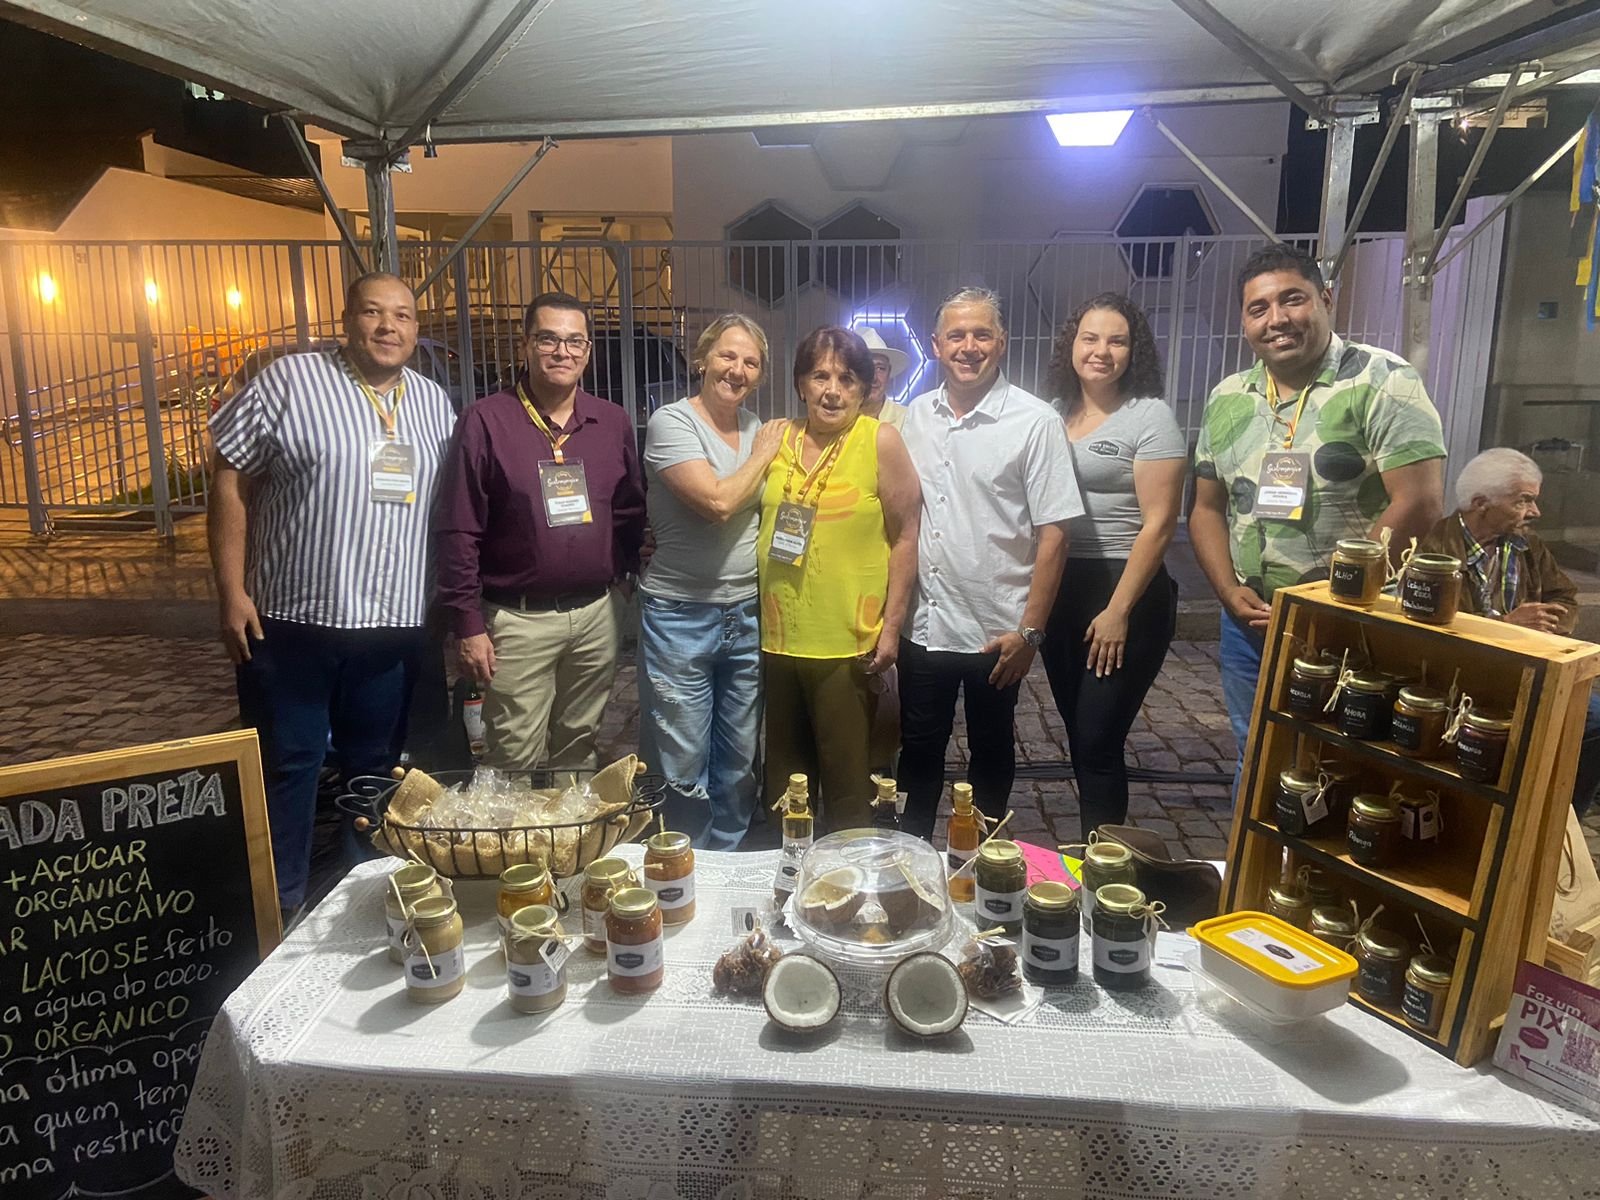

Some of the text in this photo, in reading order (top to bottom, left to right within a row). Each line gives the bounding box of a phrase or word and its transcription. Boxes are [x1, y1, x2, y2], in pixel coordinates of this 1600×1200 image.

[1334, 569, 1353, 581] ALHO
[101, 769, 226, 832] PRETA
[15, 868, 153, 918] ORGÂNICA
[54, 890, 195, 940] MASCAVO
[22, 936, 149, 994] LACTOSE
[163, 915, 233, 960] feito
[35, 988, 107, 1027] água
[113, 971, 146, 1000] do
[1520, 999, 1564, 1037] PIX
[1526, 984, 1554, 1006] Faz
[35, 996, 189, 1051] ORGÂNICO
[46, 1053, 136, 1094] ótima
[34, 1101, 119, 1152] quem
[134, 1080, 188, 1110] tem
